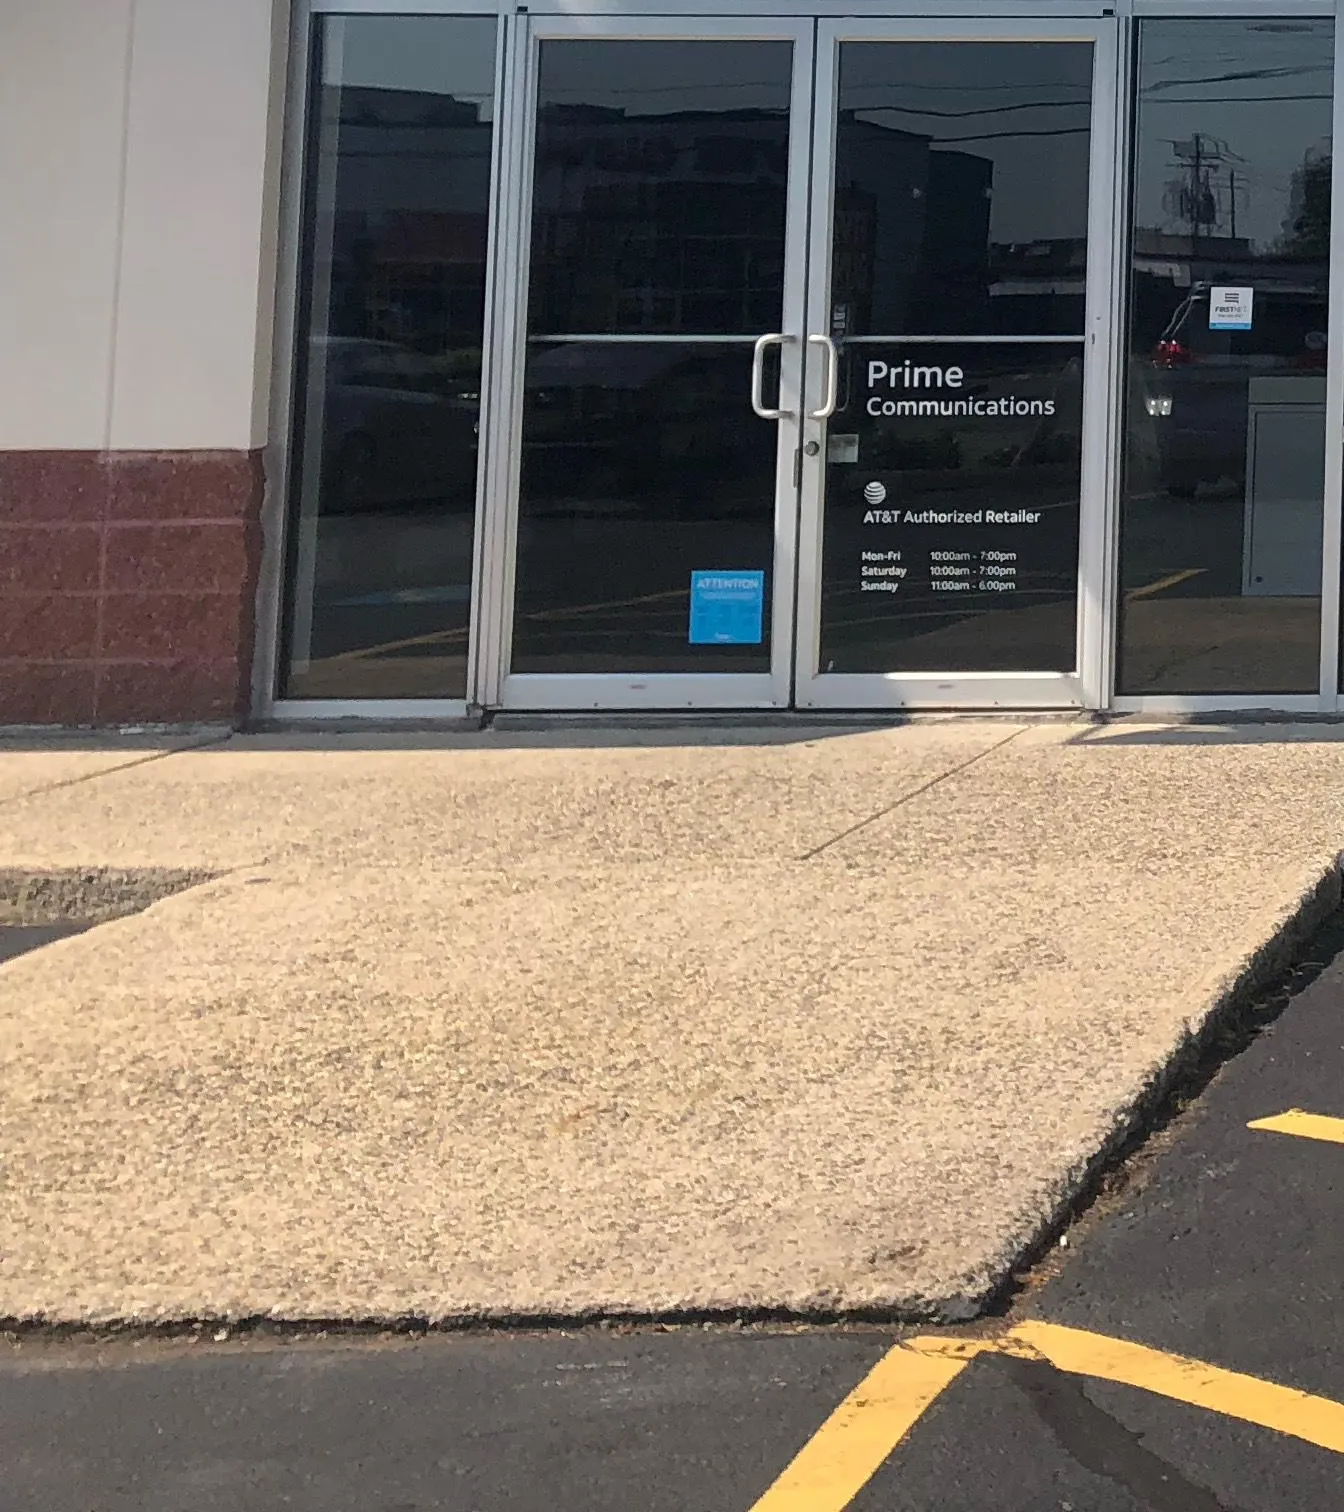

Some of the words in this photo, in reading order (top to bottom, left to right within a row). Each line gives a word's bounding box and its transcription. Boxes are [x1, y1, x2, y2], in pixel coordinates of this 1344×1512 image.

[867, 360, 964, 388] Prime
[866, 396, 1056, 416] Communications
[863, 510, 900, 524] AT&T
[903, 509, 982, 524] Authorized
[985, 509, 1041, 524] Retailer
[861, 551, 901, 561] Mon-Fri
[929, 551, 971, 561] 10:00am
[980, 551, 1017, 563] 7:00pm
[861, 566, 907, 578] Saturday
[929, 566, 970, 576] 10:00am
[979, 566, 1016, 578] 7:00pm
[860, 581, 899, 593] Sunday
